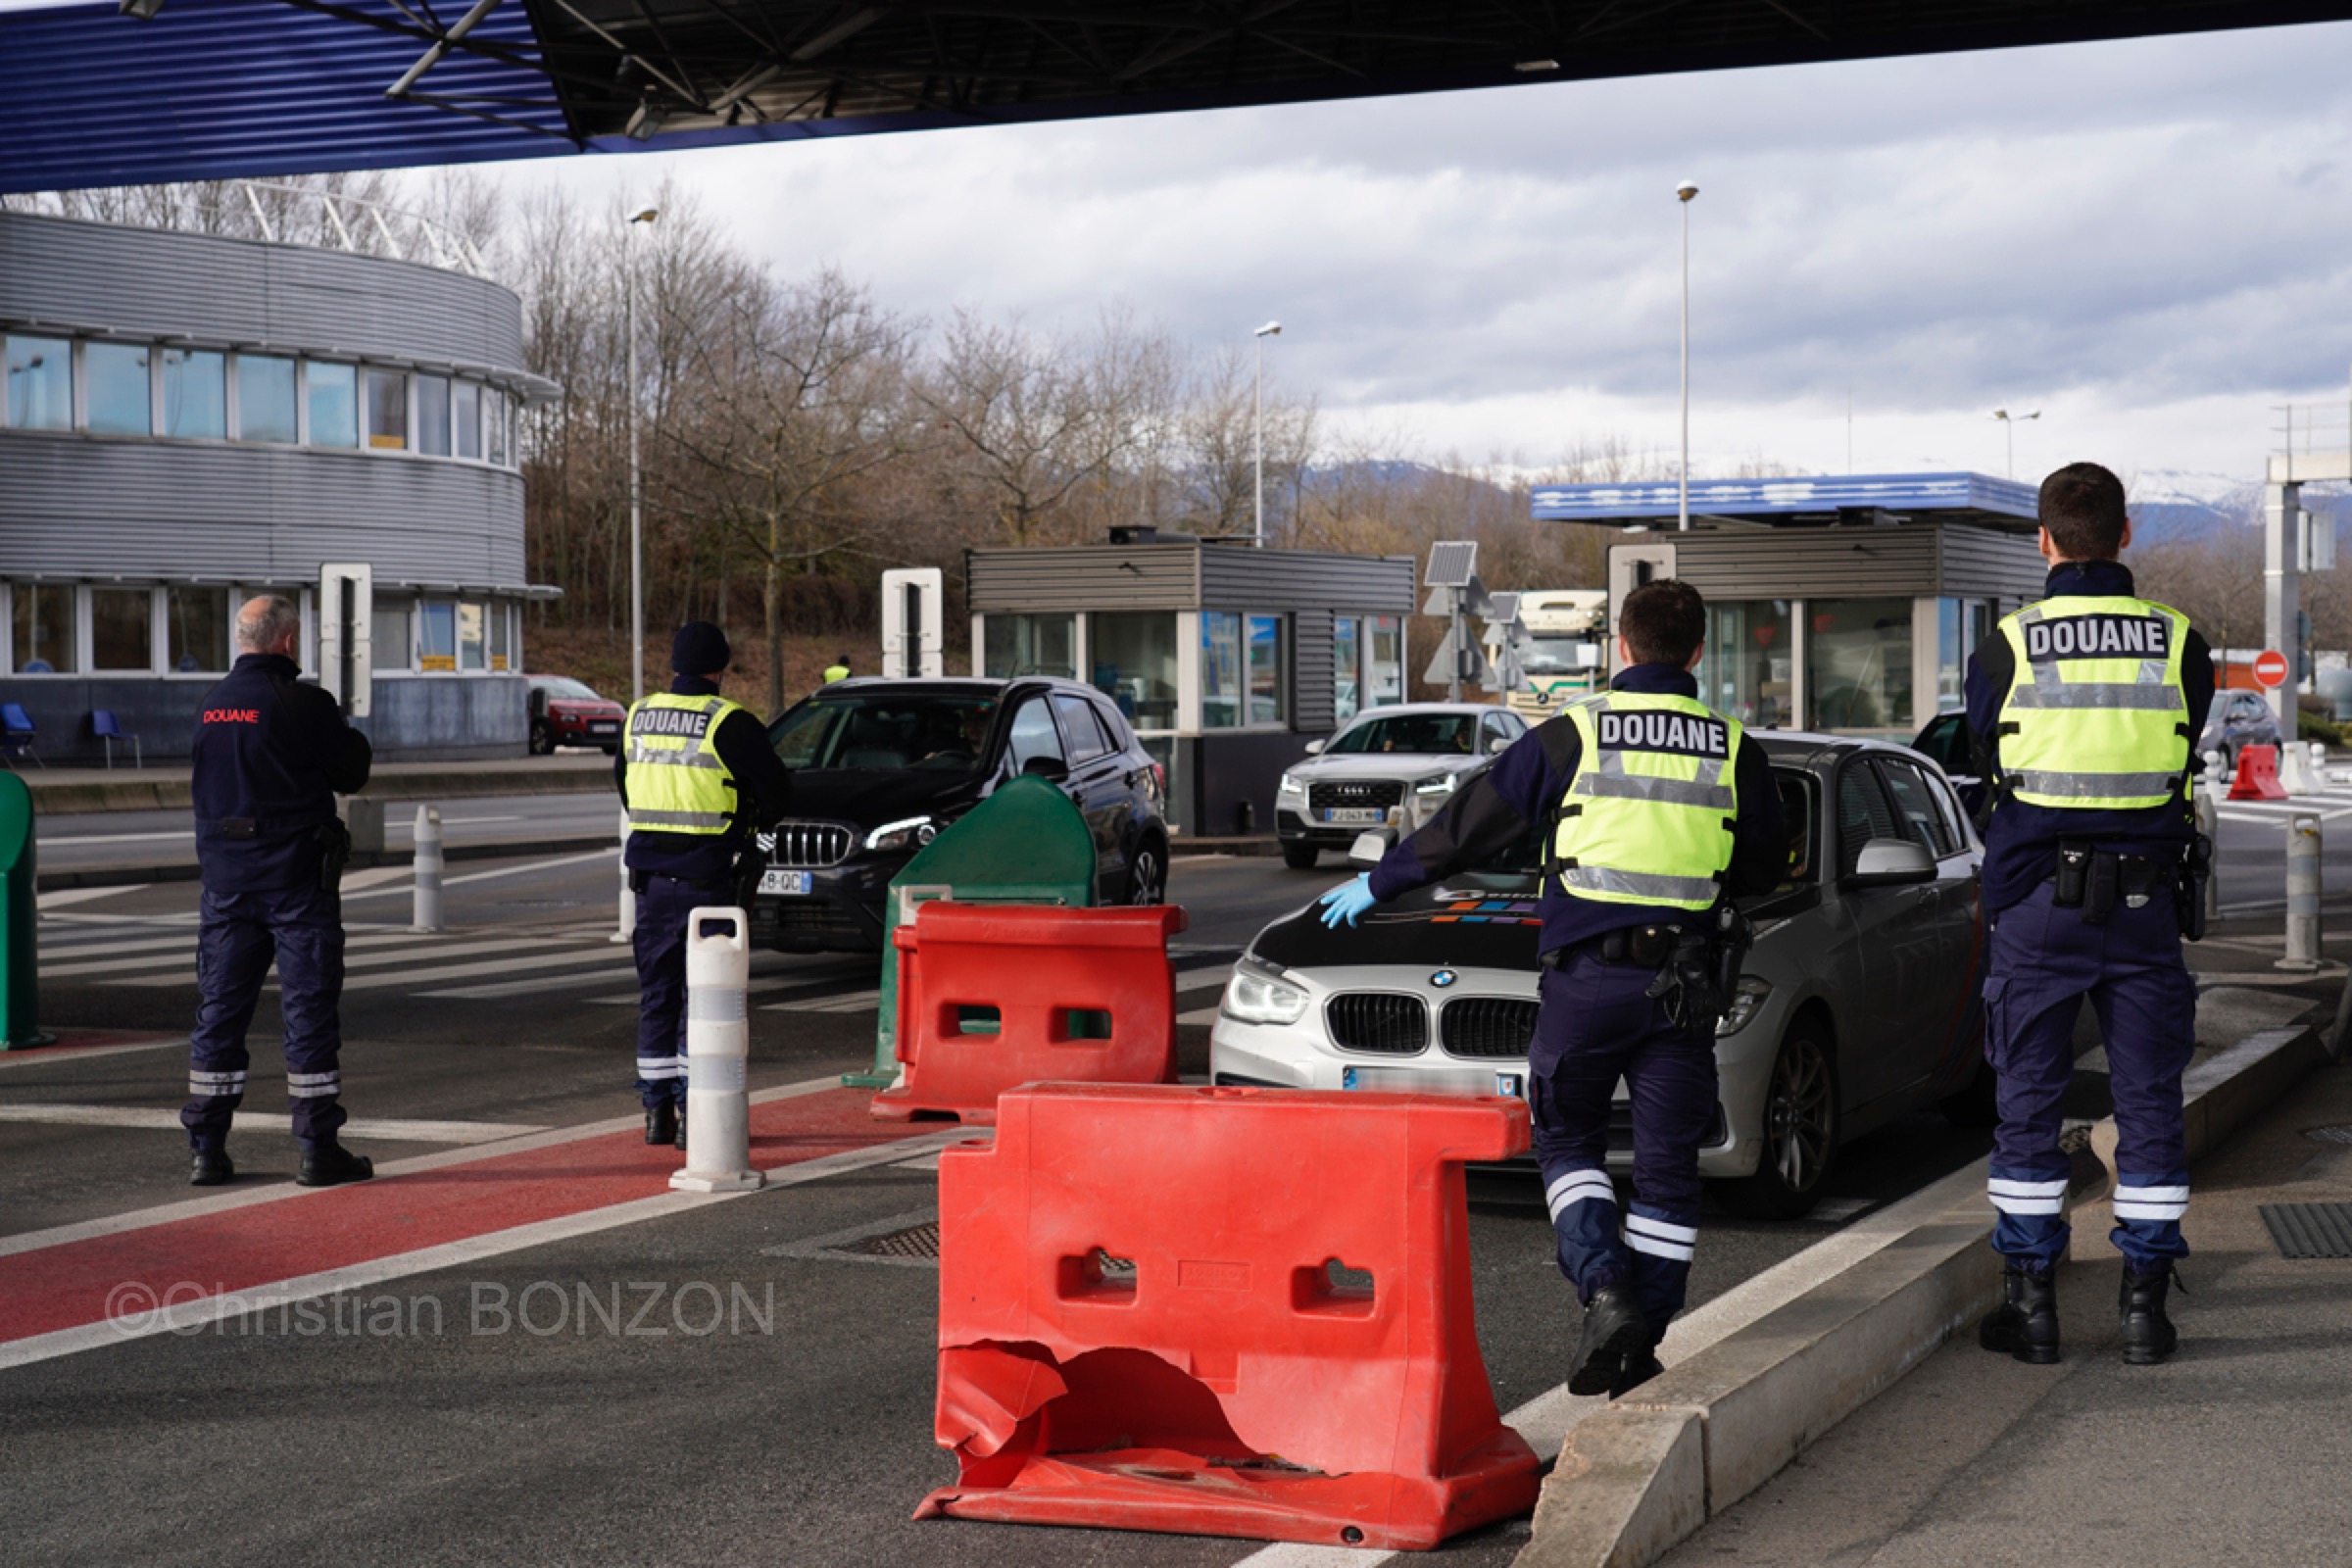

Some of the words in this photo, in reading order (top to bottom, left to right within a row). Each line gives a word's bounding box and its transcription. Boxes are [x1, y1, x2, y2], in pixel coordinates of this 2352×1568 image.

[2030, 618, 2165, 656] DOUANE
[202, 709, 260, 723] DOUANE
[631, 710, 709, 735] DOUANE
[1600, 713, 1726, 754] DOUANE
